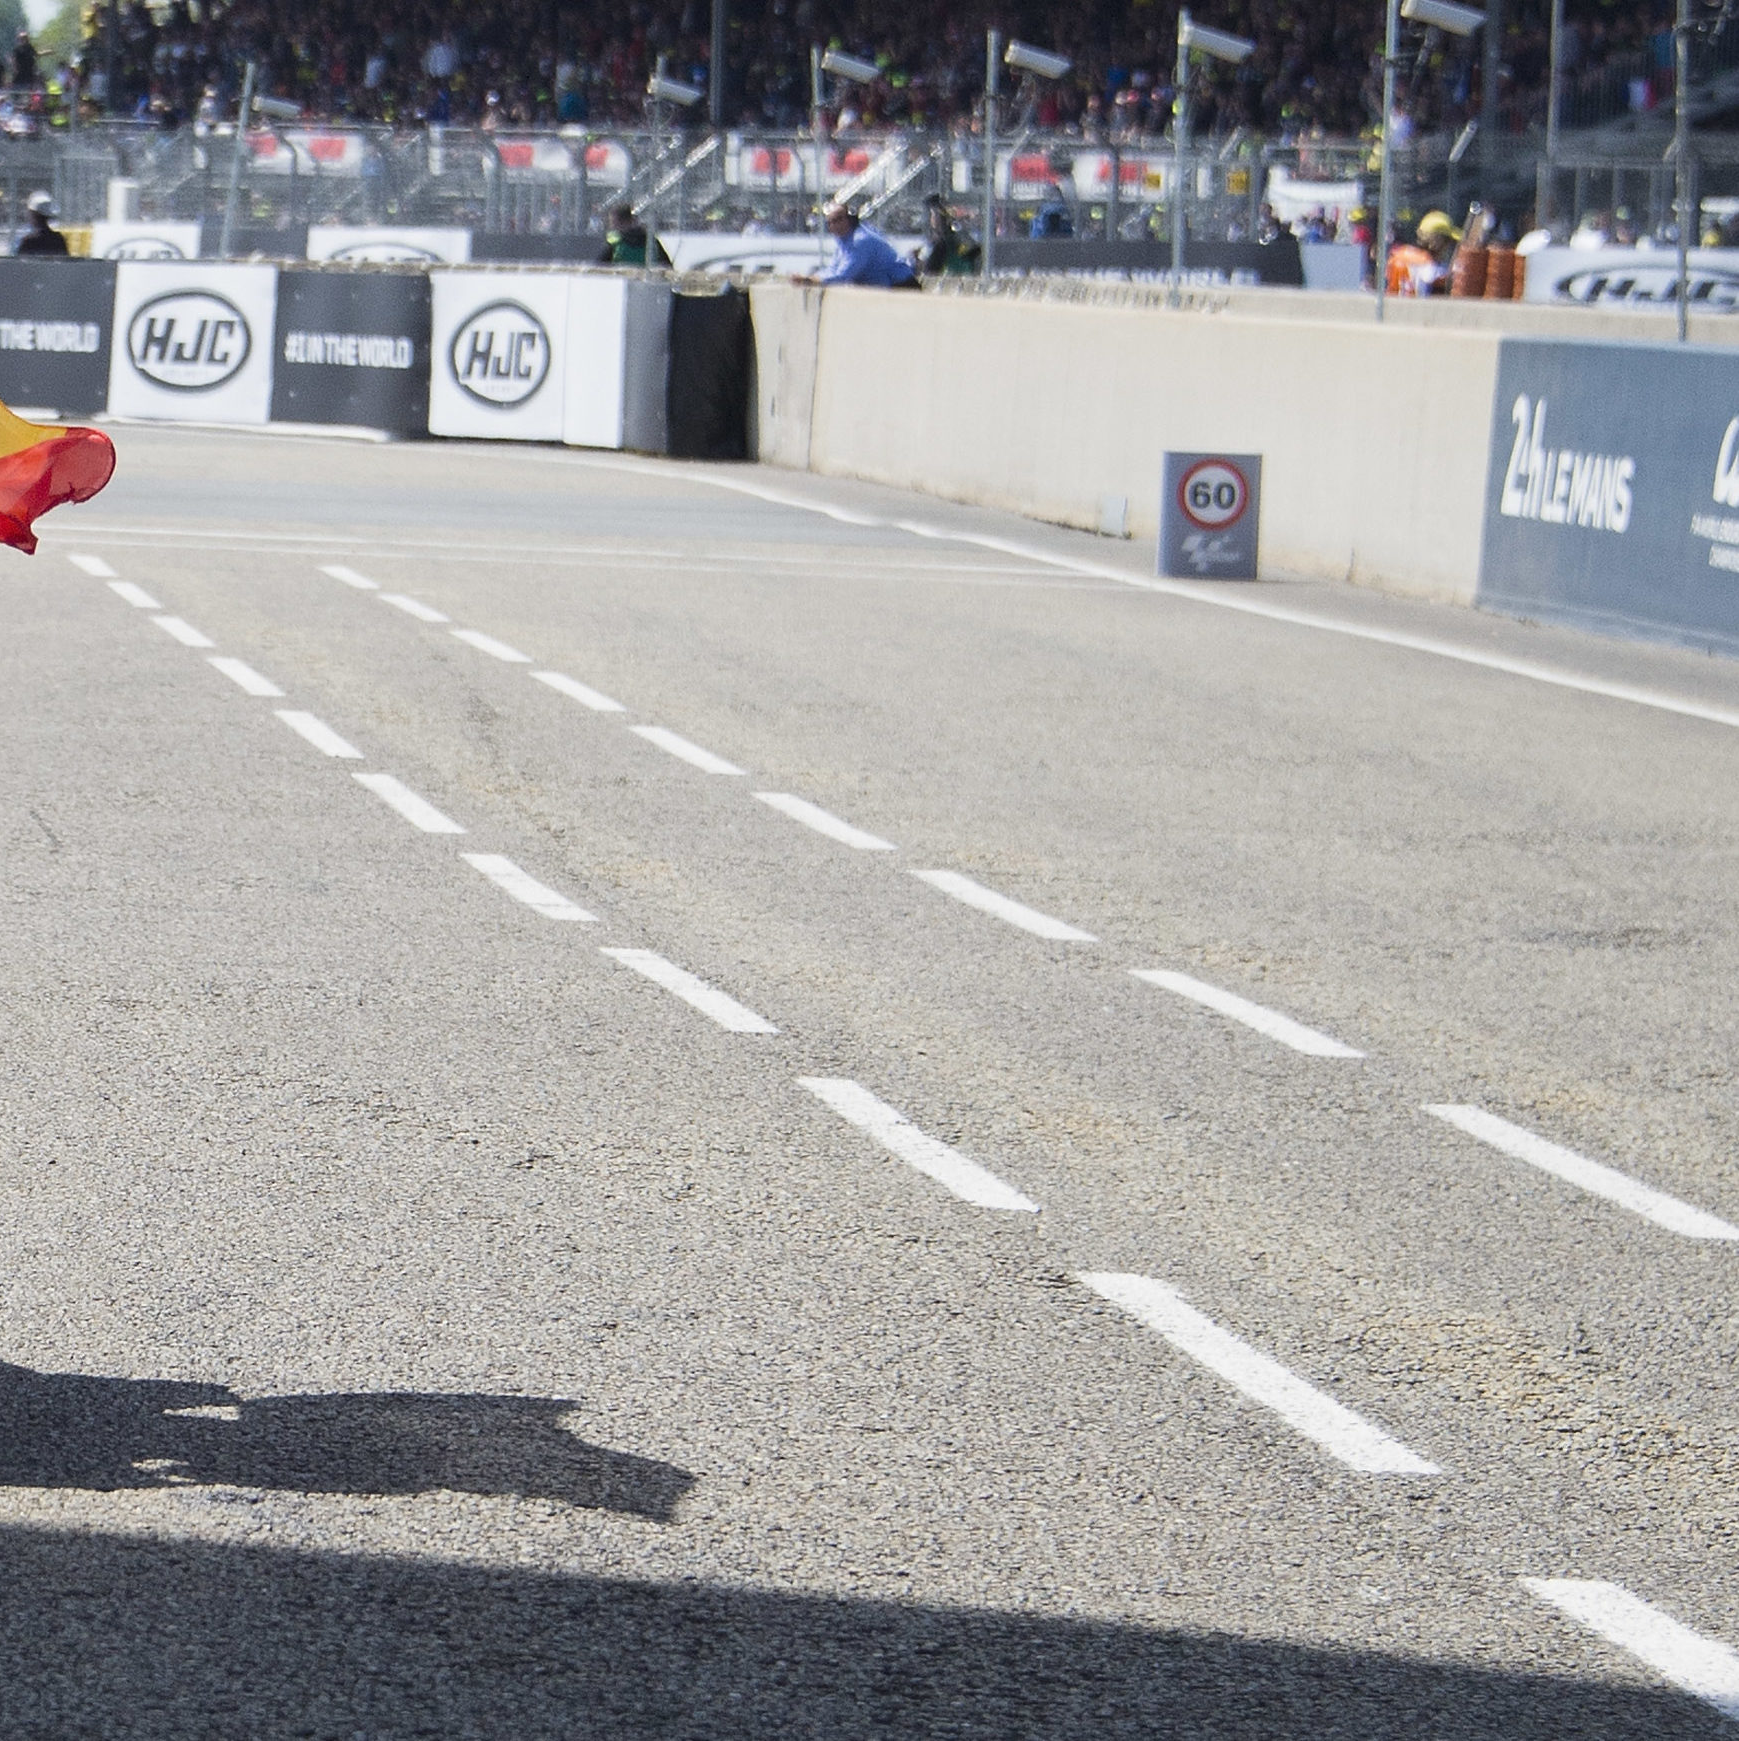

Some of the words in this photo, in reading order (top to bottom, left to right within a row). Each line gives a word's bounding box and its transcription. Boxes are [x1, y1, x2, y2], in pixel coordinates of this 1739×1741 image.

[35, 322, 100, 353] WORLD
[142, 318, 235, 362] HJC
[324, 333, 357, 365] THE
[358, 335, 412, 369] WORLD
[466, 331, 537, 379] HJC
[1189, 481, 1235, 510] 60
